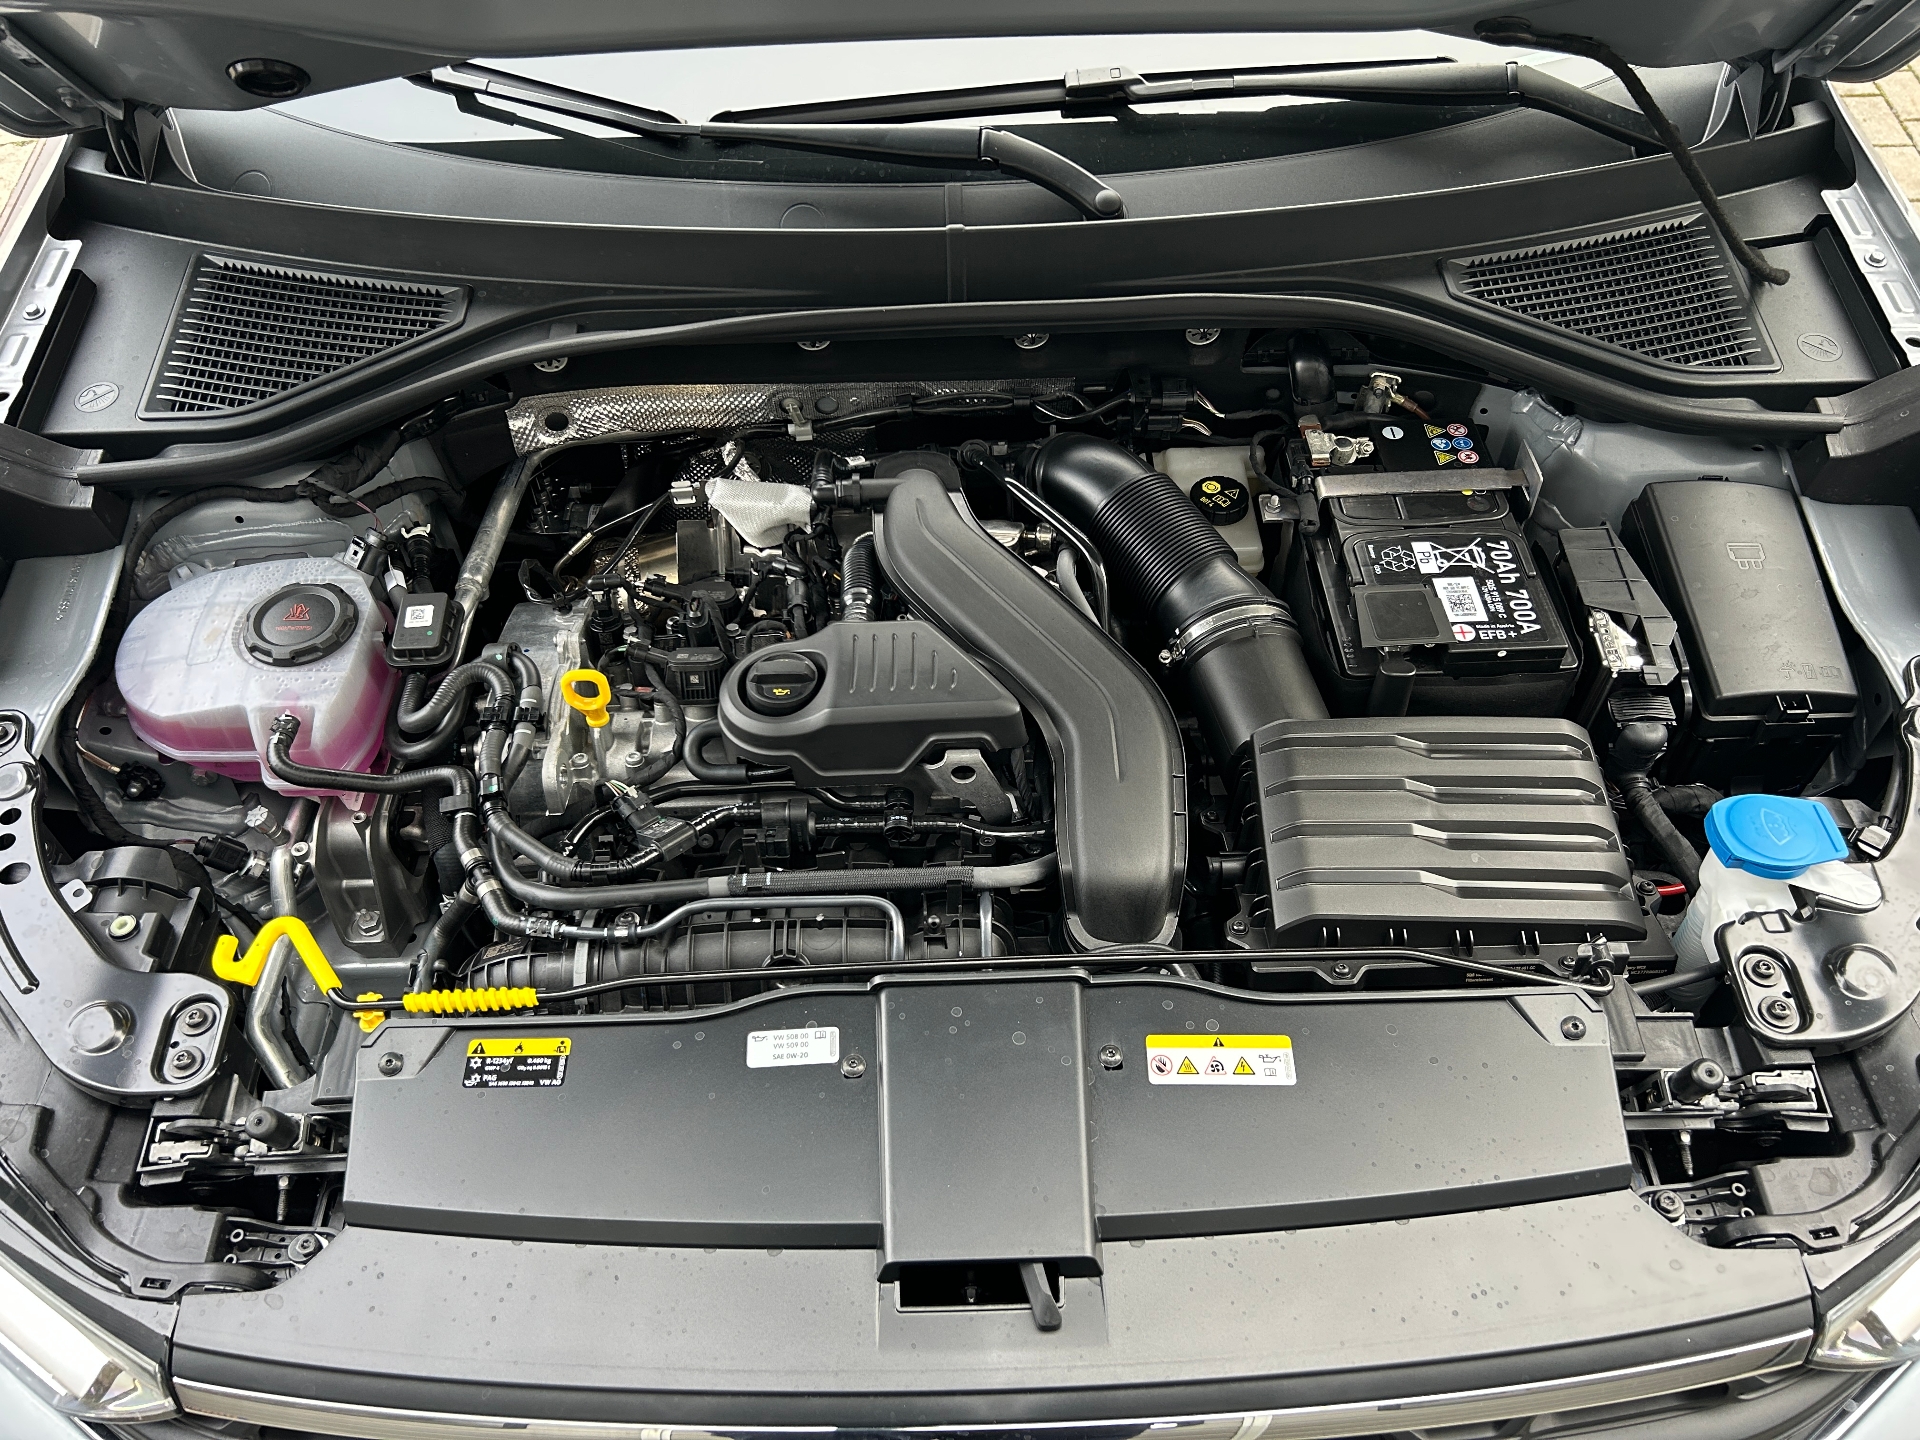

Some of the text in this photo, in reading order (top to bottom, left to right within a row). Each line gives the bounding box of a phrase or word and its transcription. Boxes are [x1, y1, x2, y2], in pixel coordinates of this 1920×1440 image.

[1417, 551, 1432, 564] Pb
[1486, 540, 1541, 635] 70Ah 700A
[1478, 630, 1507, 640] EFB
[799, 1032, 809, 1040] 00
[786, 1051, 809, 1060] 0W-20
